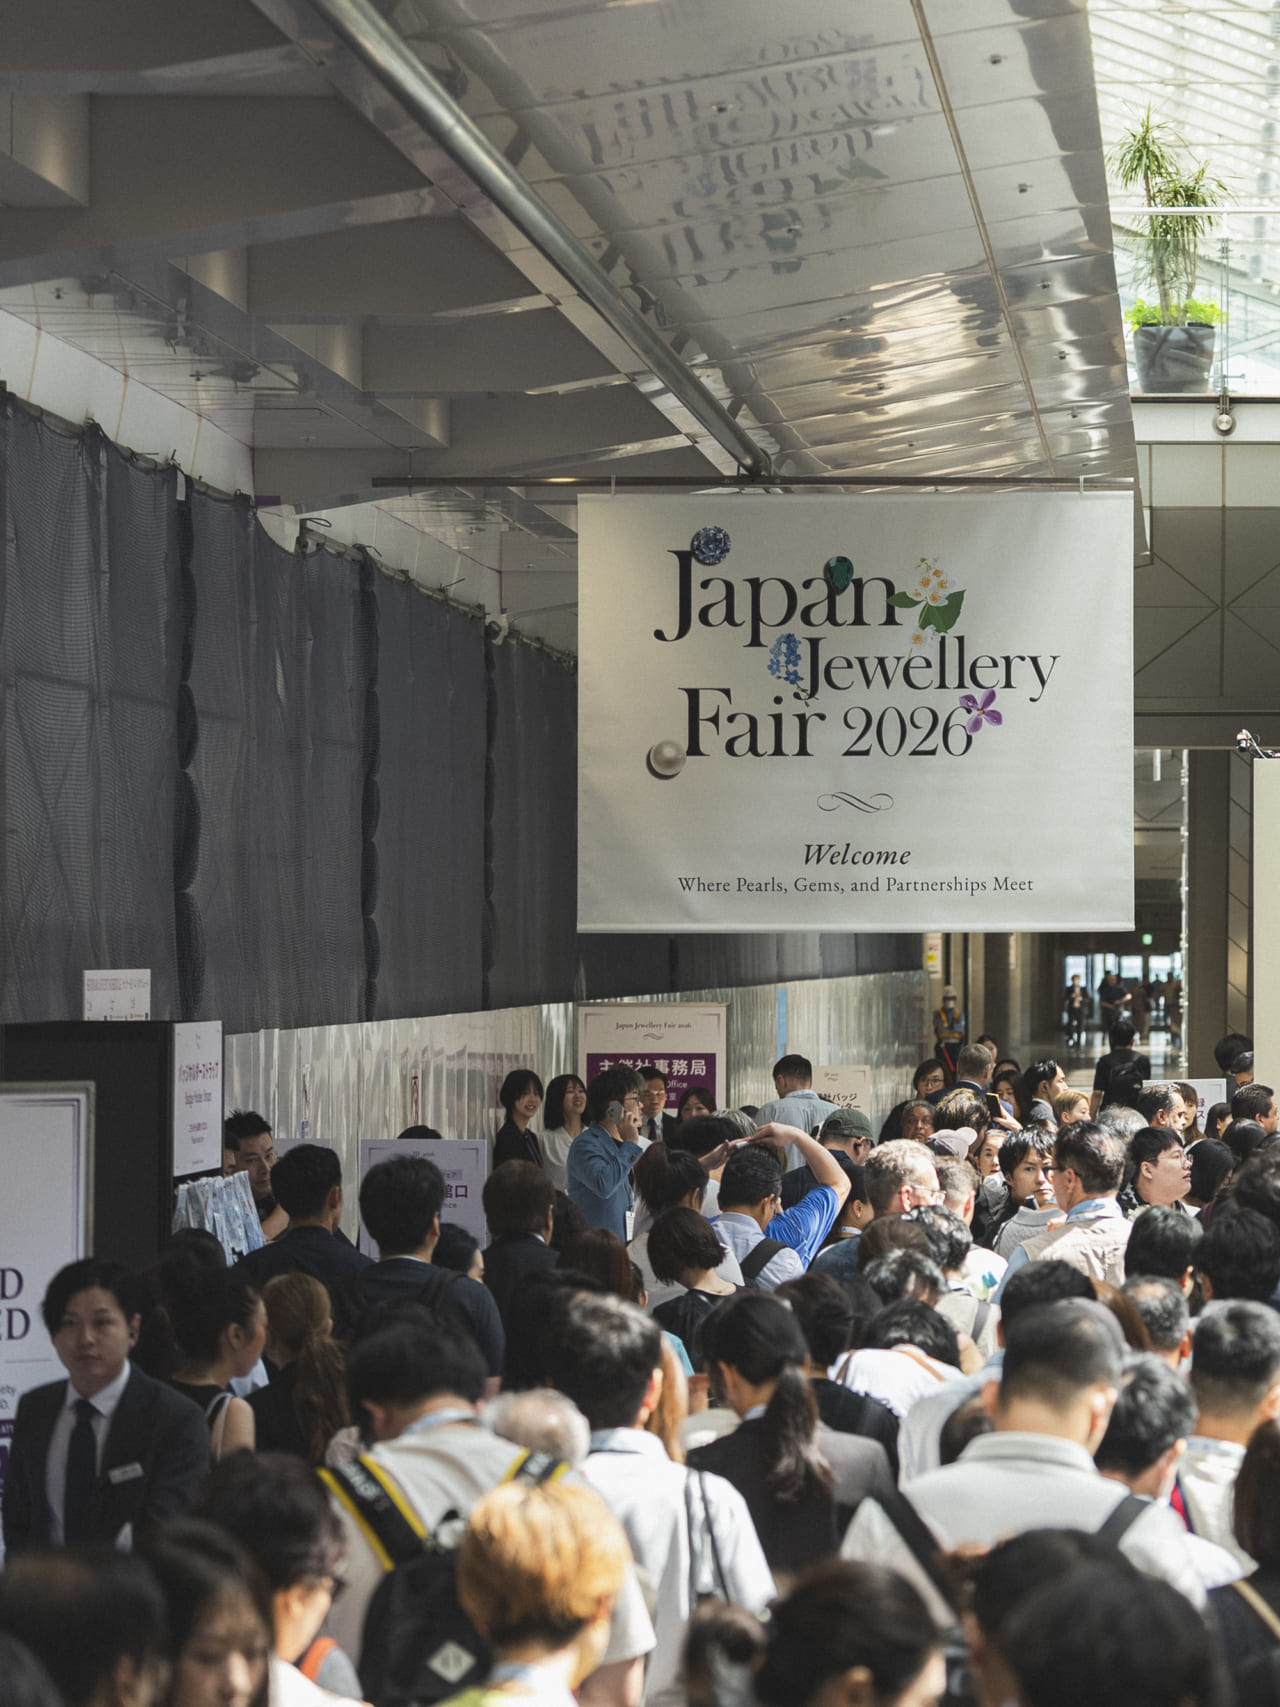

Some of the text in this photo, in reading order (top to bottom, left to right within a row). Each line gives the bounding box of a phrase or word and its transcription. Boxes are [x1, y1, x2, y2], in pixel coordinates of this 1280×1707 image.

[653, 550, 903, 647] Japan
[793, 635, 1060, 702] Jewellery
[678, 687, 973, 757] Fair 2026
[803, 843, 912, 865] Welcome
[678, 876, 1034, 896] Where Pearls, Gems, and Partnerships Meet
[616, 1022, 633, 1030] Japan
[634, 1021, 662, 1030] Jewellery
